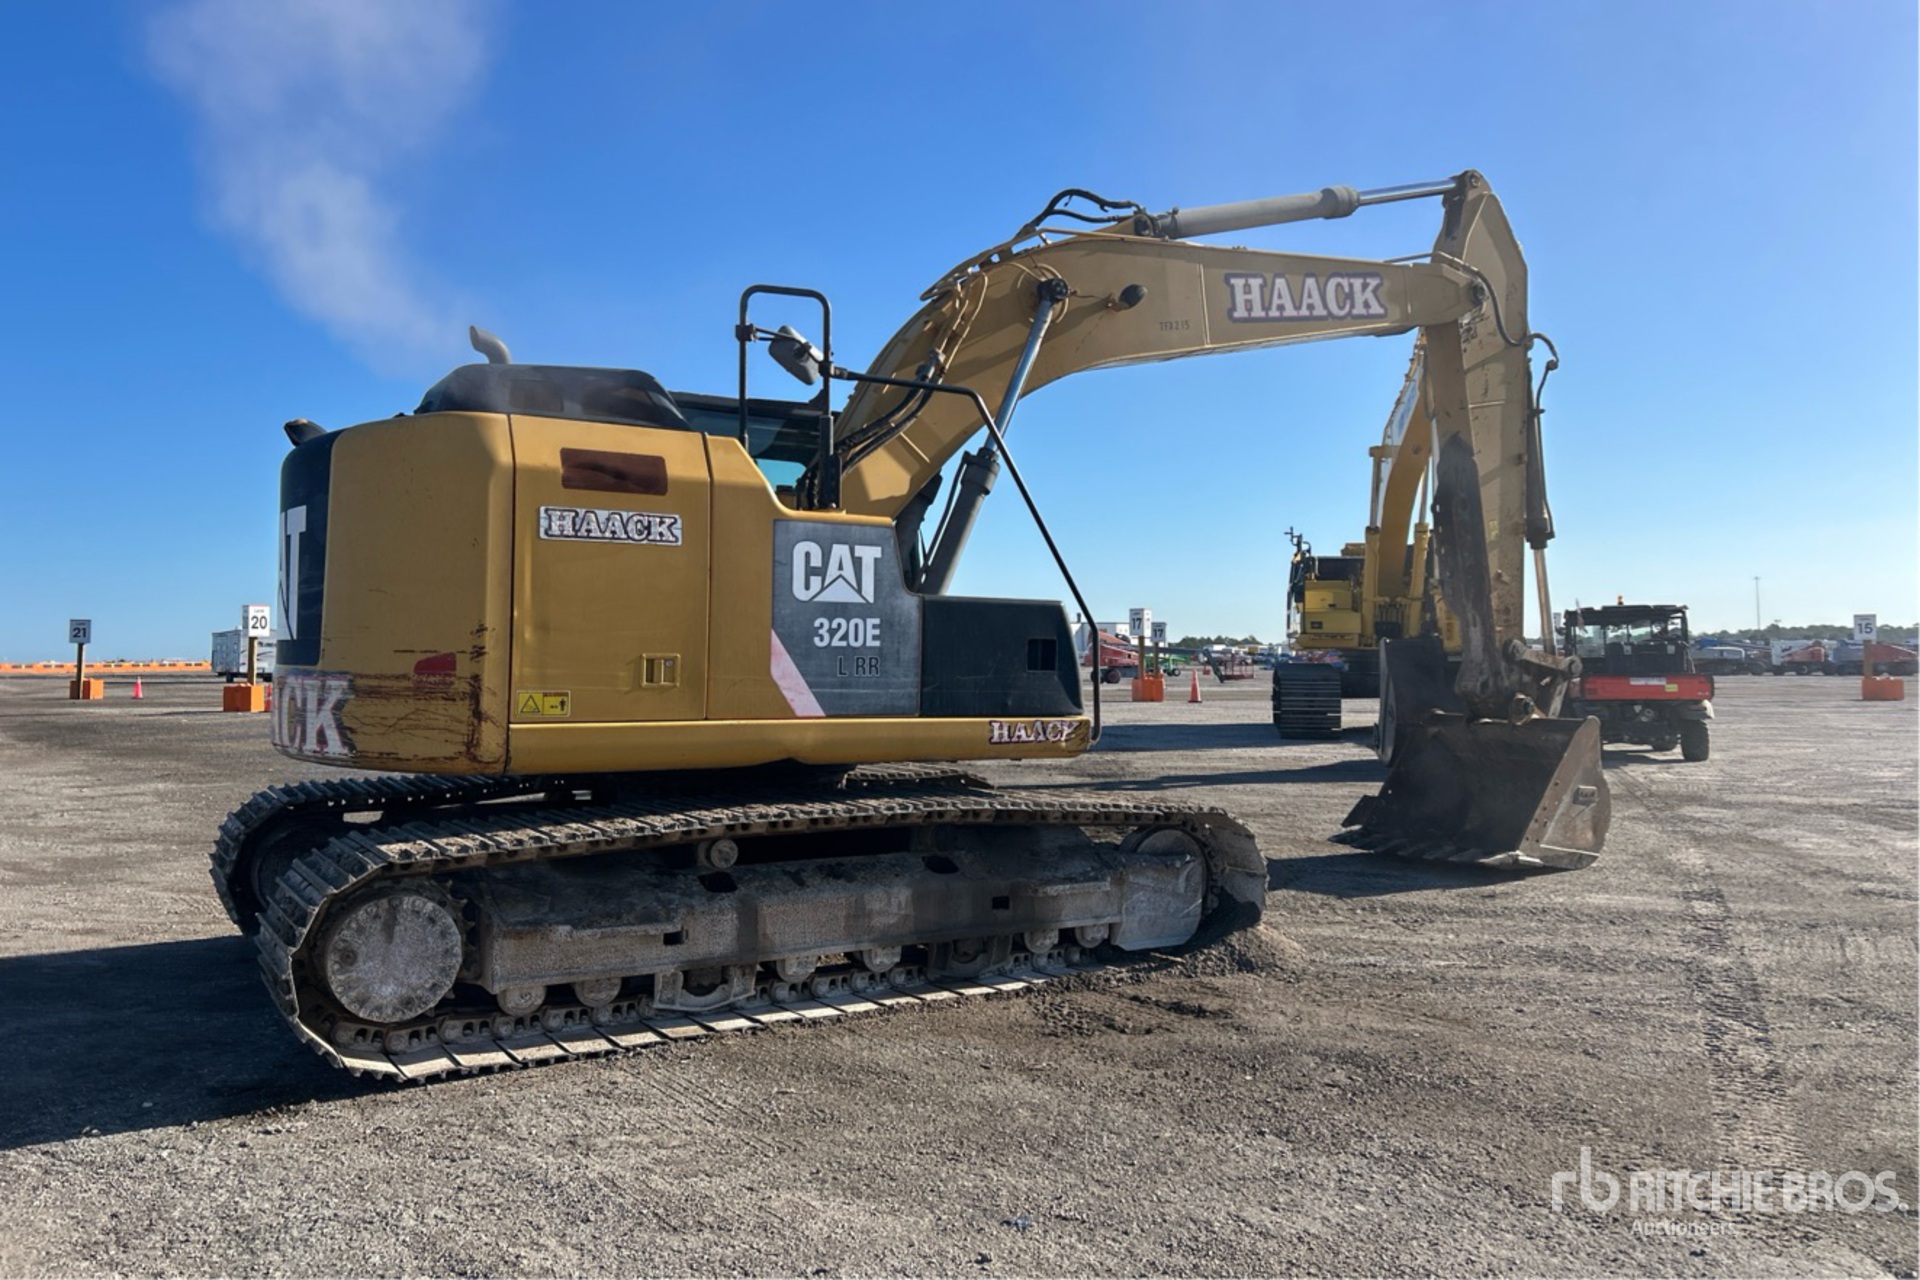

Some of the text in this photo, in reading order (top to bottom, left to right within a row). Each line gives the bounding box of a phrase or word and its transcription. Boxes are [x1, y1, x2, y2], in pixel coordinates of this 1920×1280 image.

[1226, 273, 1386, 321] HAACK
[544, 508, 679, 542] HAACK
[792, 540, 882, 604] CAT
[251, 615, 268, 629] 20
[1131, 617, 1142, 630] 17
[1857, 622, 1873, 634] 15
[73, 627, 86, 638] 21
[813, 617, 881, 648] 320E
[1153, 629, 1164, 638] 17
[837, 656, 881, 677] L RR
